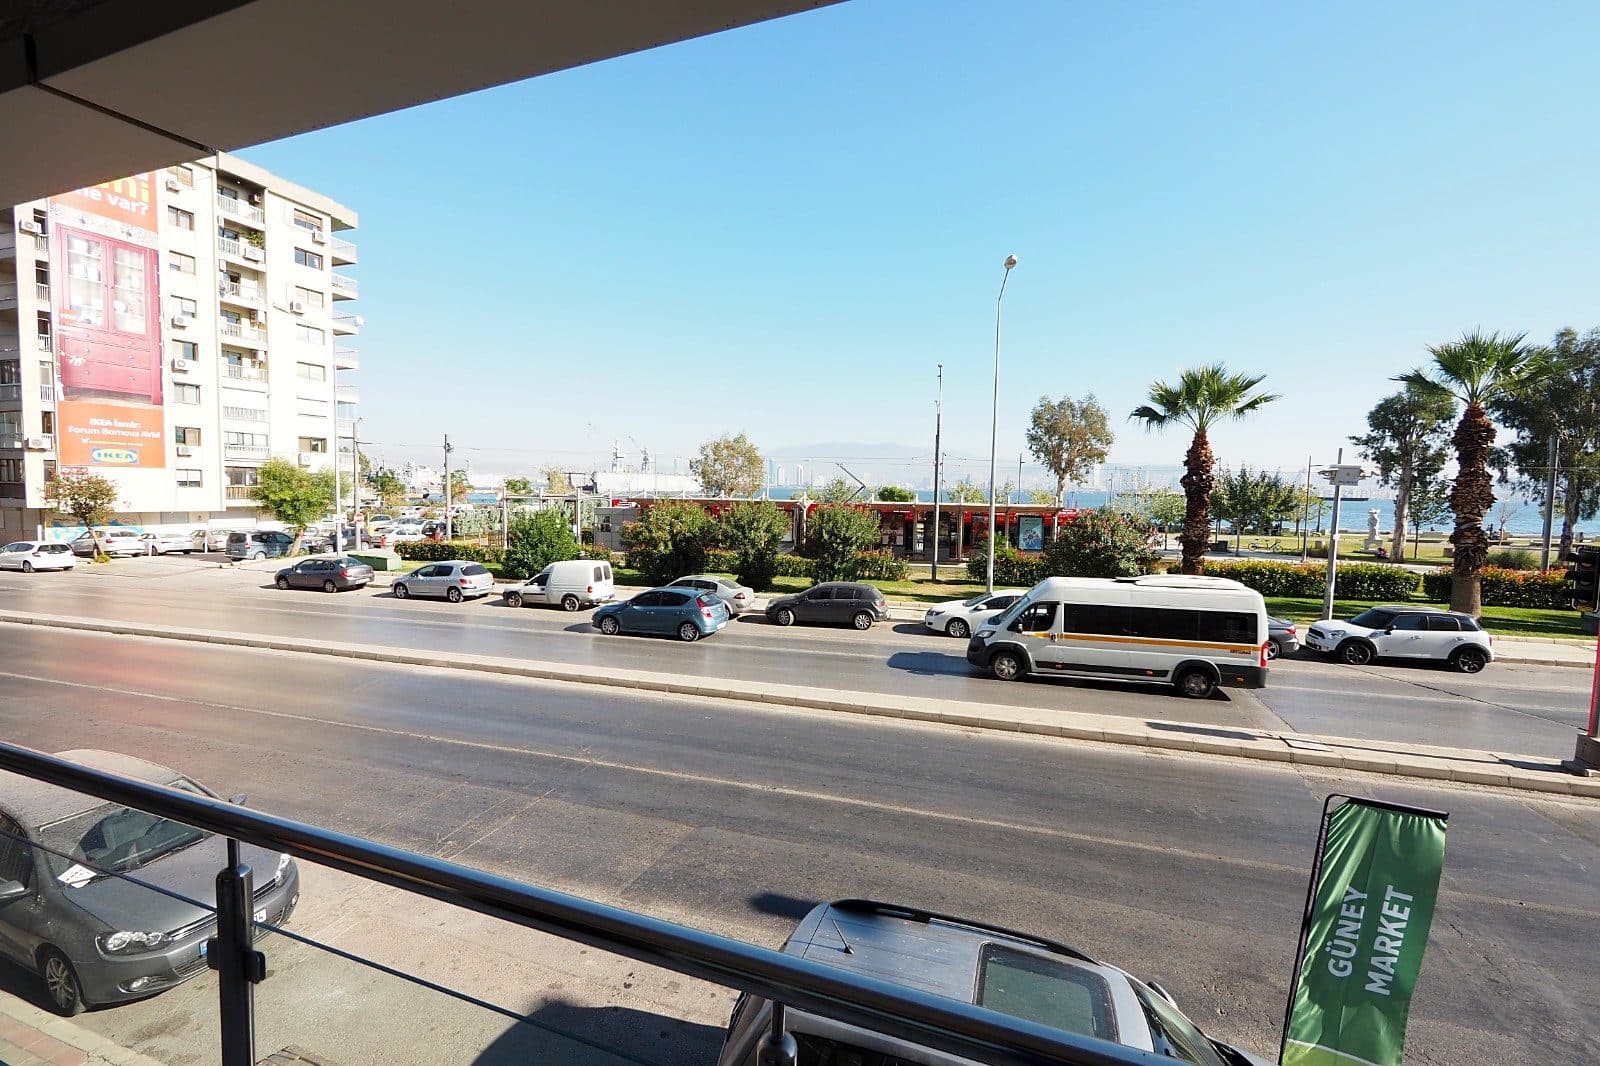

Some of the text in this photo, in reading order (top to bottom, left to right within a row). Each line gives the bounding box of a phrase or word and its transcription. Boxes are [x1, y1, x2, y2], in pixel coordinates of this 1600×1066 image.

[106, 193, 149, 216] var?
[90, 418, 113, 427] IKEA
[68, 426, 160, 439] Forum Bornova AVM
[97, 452, 134, 460] IKEA
[1325, 884, 1368, 977] GÜNEY
[1364, 884, 1413, 996] MARKET
